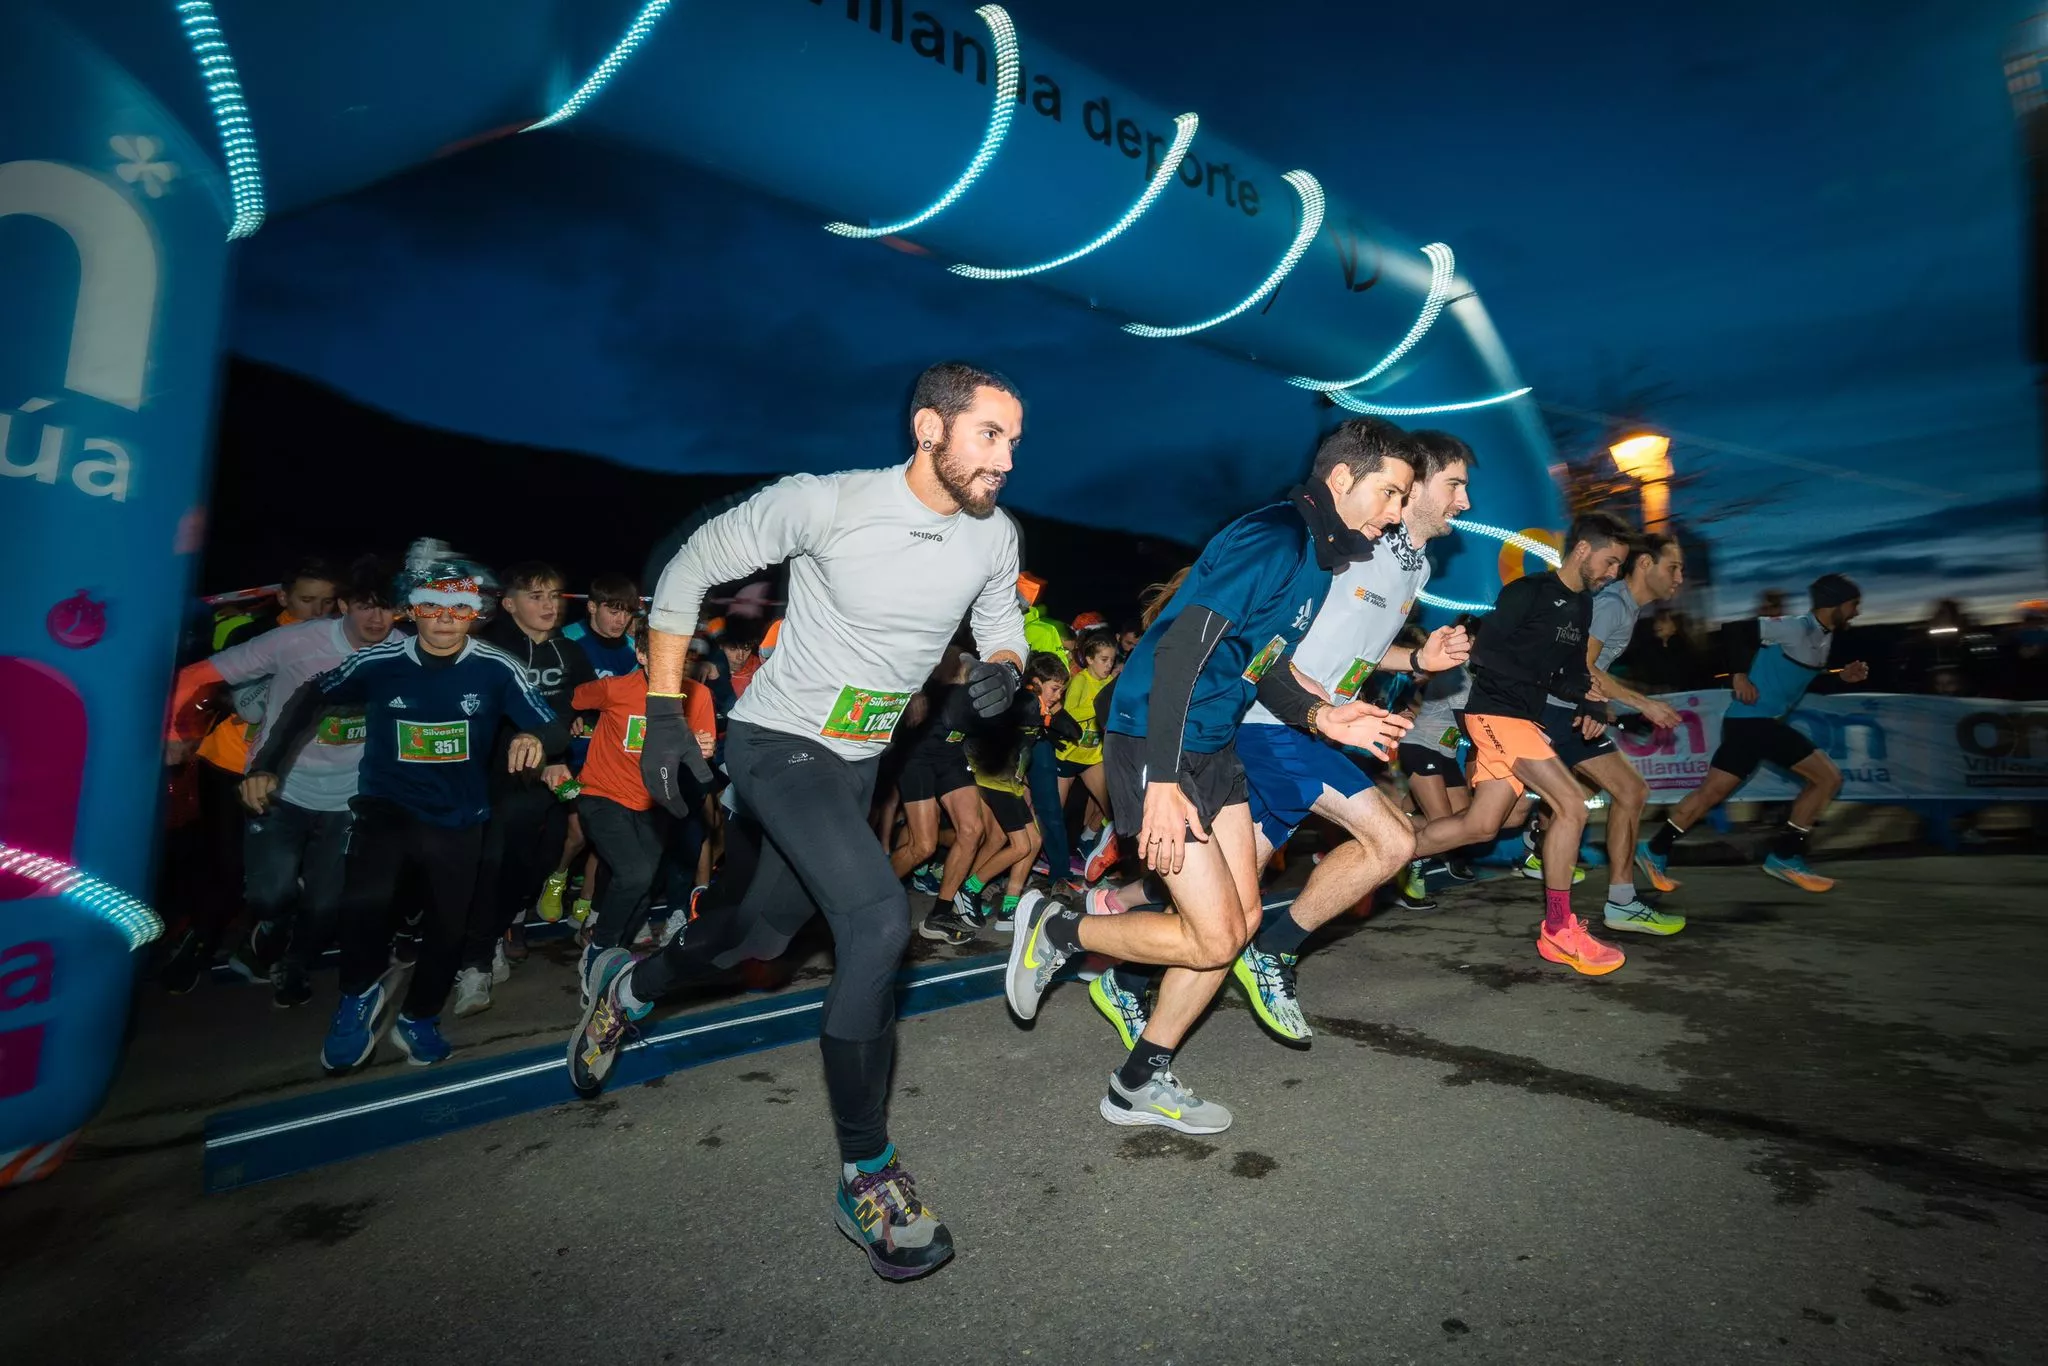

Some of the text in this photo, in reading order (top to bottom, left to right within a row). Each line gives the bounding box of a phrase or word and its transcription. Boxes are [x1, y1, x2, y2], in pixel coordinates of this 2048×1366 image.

[863, 711, 899, 732] 1262
[422, 727, 465, 736] Silvestre
[434, 738, 460, 754] 351
